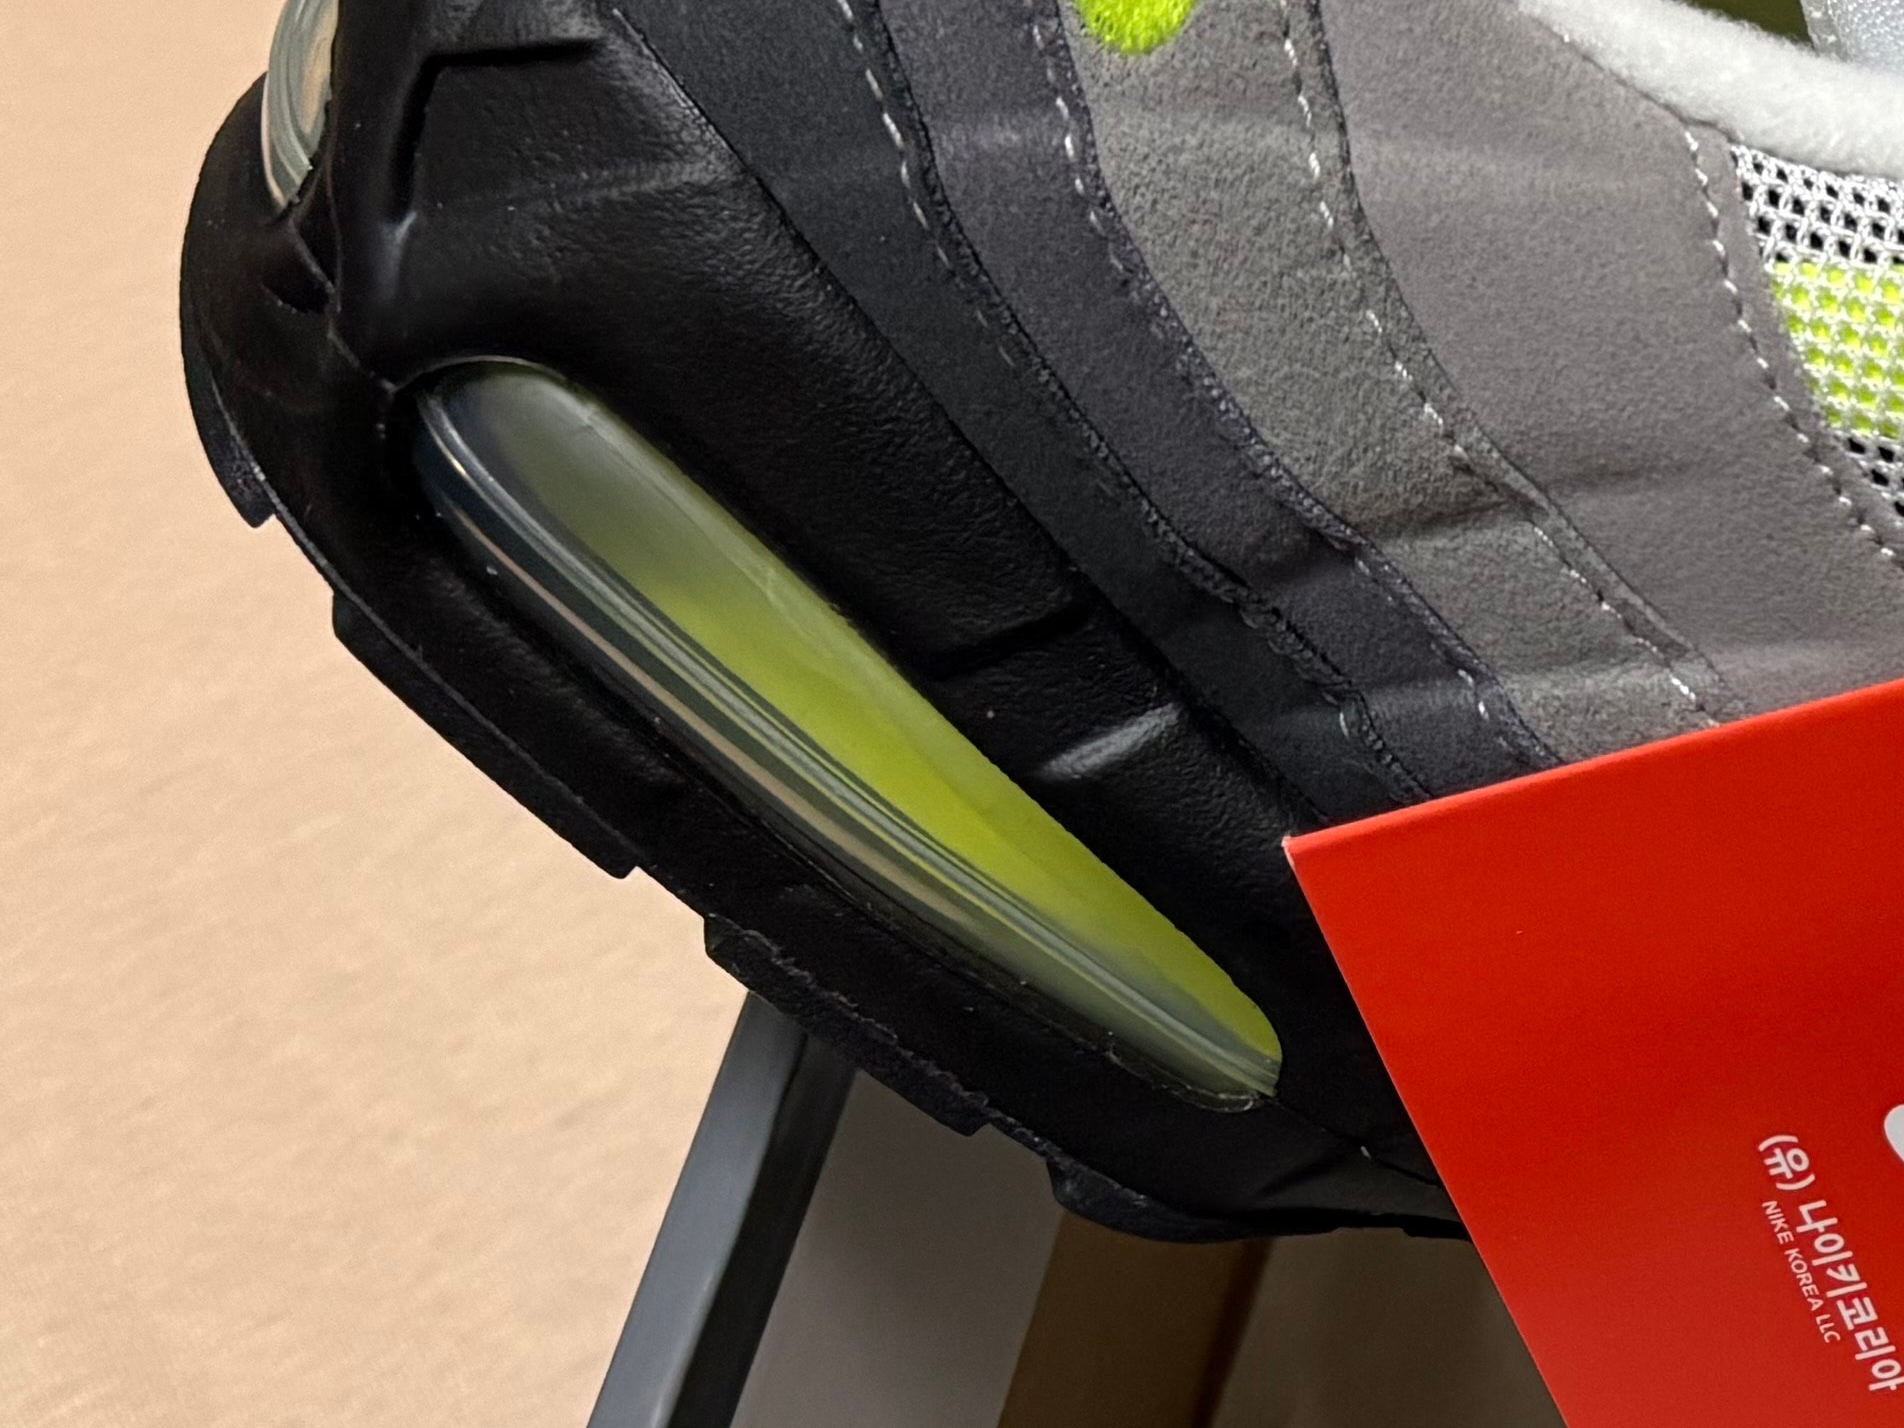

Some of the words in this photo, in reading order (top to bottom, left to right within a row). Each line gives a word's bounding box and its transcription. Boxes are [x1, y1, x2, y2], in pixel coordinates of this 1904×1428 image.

[1757, 1134, 1816, 1191] (유)
[1761, 1200, 1795, 1245] NIKE
[1784, 1247, 1825, 1312] KOREA
[1815, 1313, 1841, 1344] LLC
